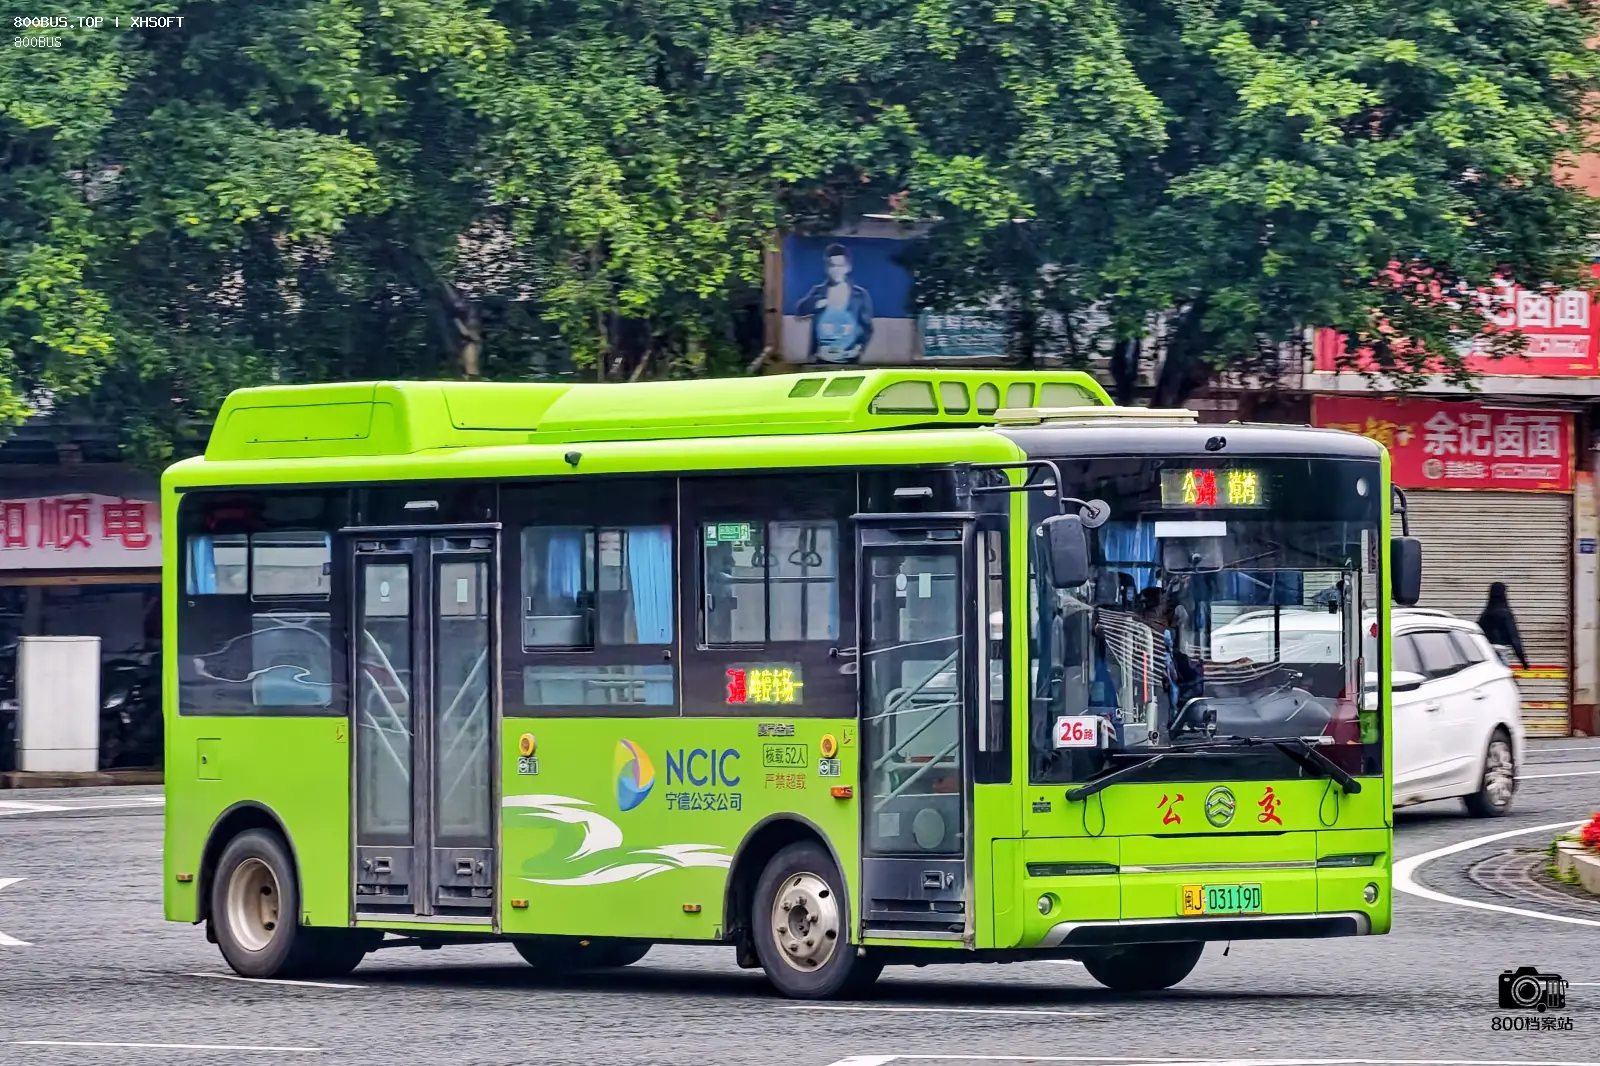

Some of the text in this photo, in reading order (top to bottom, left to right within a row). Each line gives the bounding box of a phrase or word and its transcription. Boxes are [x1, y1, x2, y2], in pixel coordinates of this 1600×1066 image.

[1423, 411, 1562, 458] 余记卤面
[1060, 721, 1093, 741] 26路
[666, 748, 741, 787] NCIC
[764, 773, 807, 790] 严禁超载
[665, 791, 742, 812] 宁德公交公司
[1157, 786, 1283, 826] 公 交
